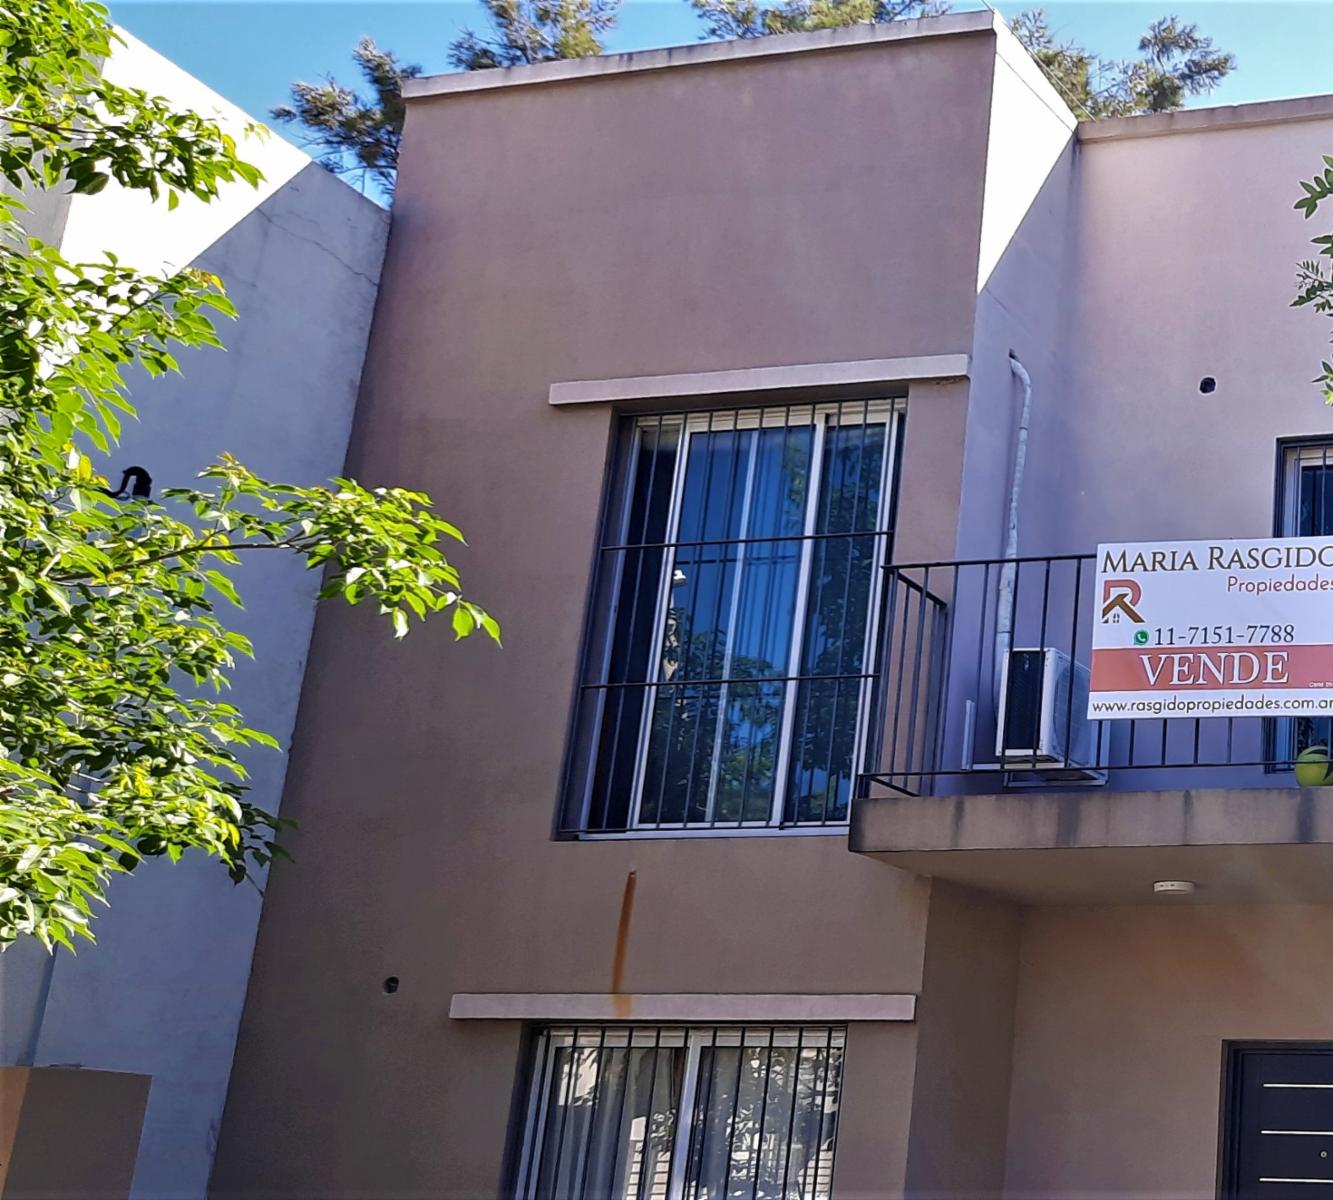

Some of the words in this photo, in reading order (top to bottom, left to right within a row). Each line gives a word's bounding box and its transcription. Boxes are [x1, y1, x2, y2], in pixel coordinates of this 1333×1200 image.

[1102, 550, 1198, 572] MARIA
[1154, 625, 1294, 645] 11-7151-7788
[1140, 652, 1289, 685] VENDE
